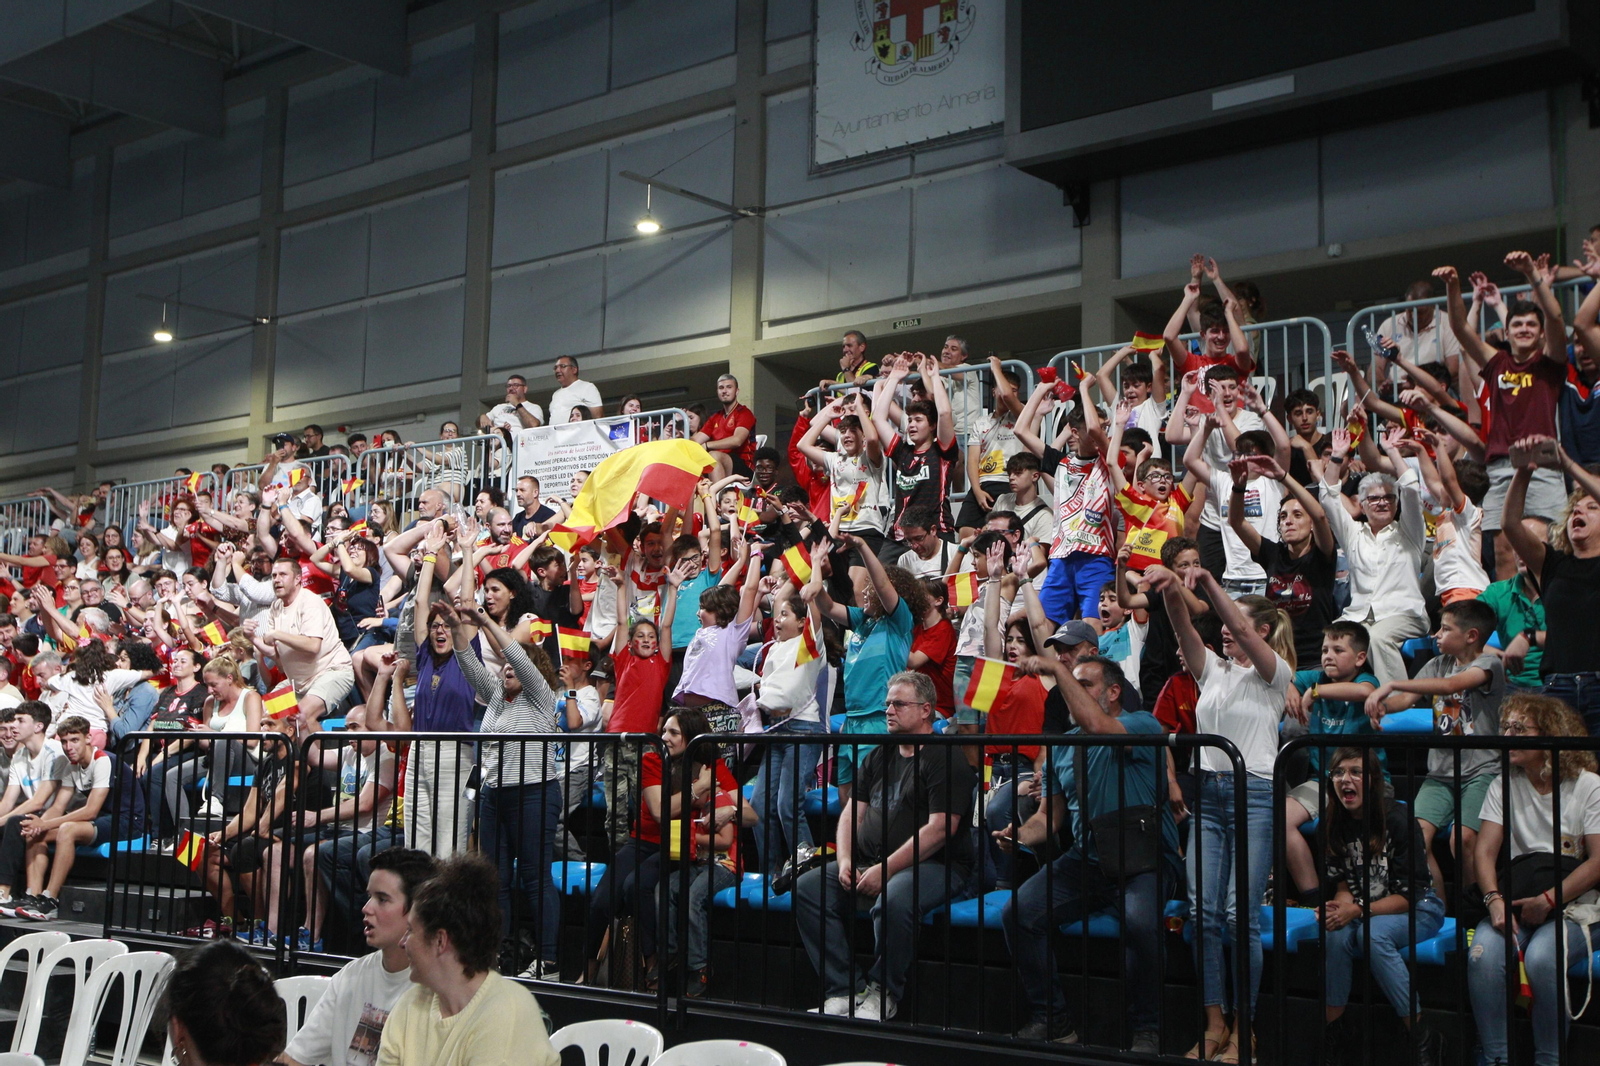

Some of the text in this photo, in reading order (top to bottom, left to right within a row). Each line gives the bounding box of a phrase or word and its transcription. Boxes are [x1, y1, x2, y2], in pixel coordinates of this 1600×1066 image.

[883, 70, 909, 83] CIUDAD
[832, 83, 996, 139] Ayuntamiento Almería
[524, 467, 552, 475] PROYECTORES
[553, 464, 579, 472] DEPORTIVOS
[1132, 542, 1157, 555] Correos
